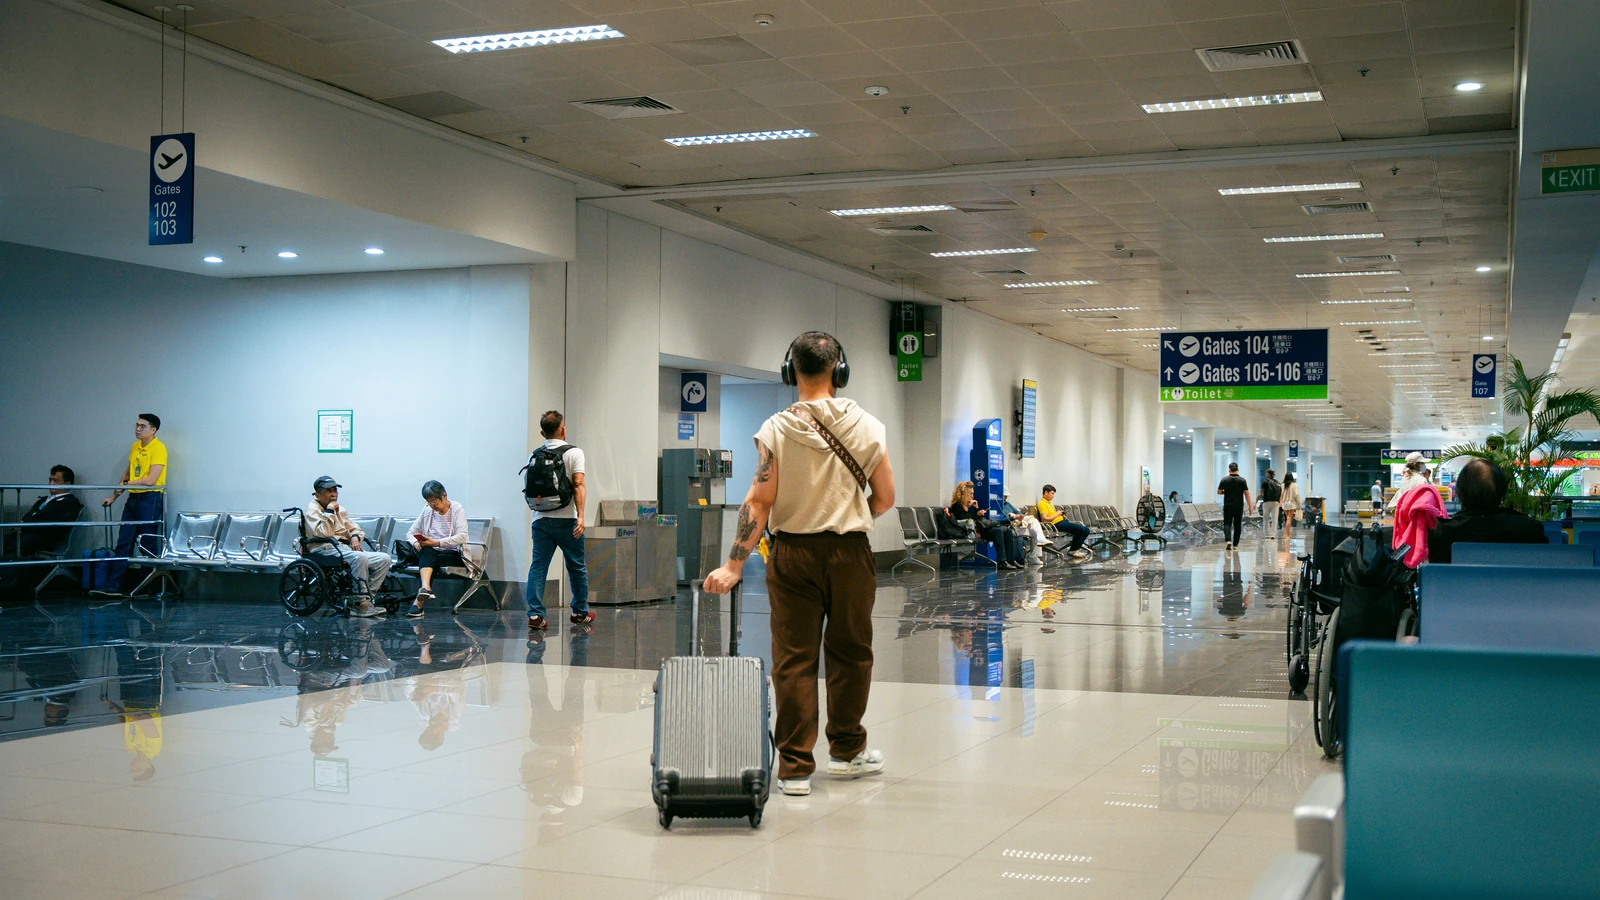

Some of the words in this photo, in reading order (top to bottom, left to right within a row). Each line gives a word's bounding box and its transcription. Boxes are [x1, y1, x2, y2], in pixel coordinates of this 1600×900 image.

[1559, 168, 1596, 187] EXIT
[154, 184, 181, 195] Gates
[154, 201, 177, 218] 102
[153, 219, 177, 236] 103
[1202, 336, 1240, 356] Gates
[1244, 335, 1270, 354] 104
[1202, 363, 1240, 382] Gates
[1244, 362, 1301, 382] 105-106
[1185, 388, 1222, 399] Toilet
[623, 529, 635, 537] Paper
